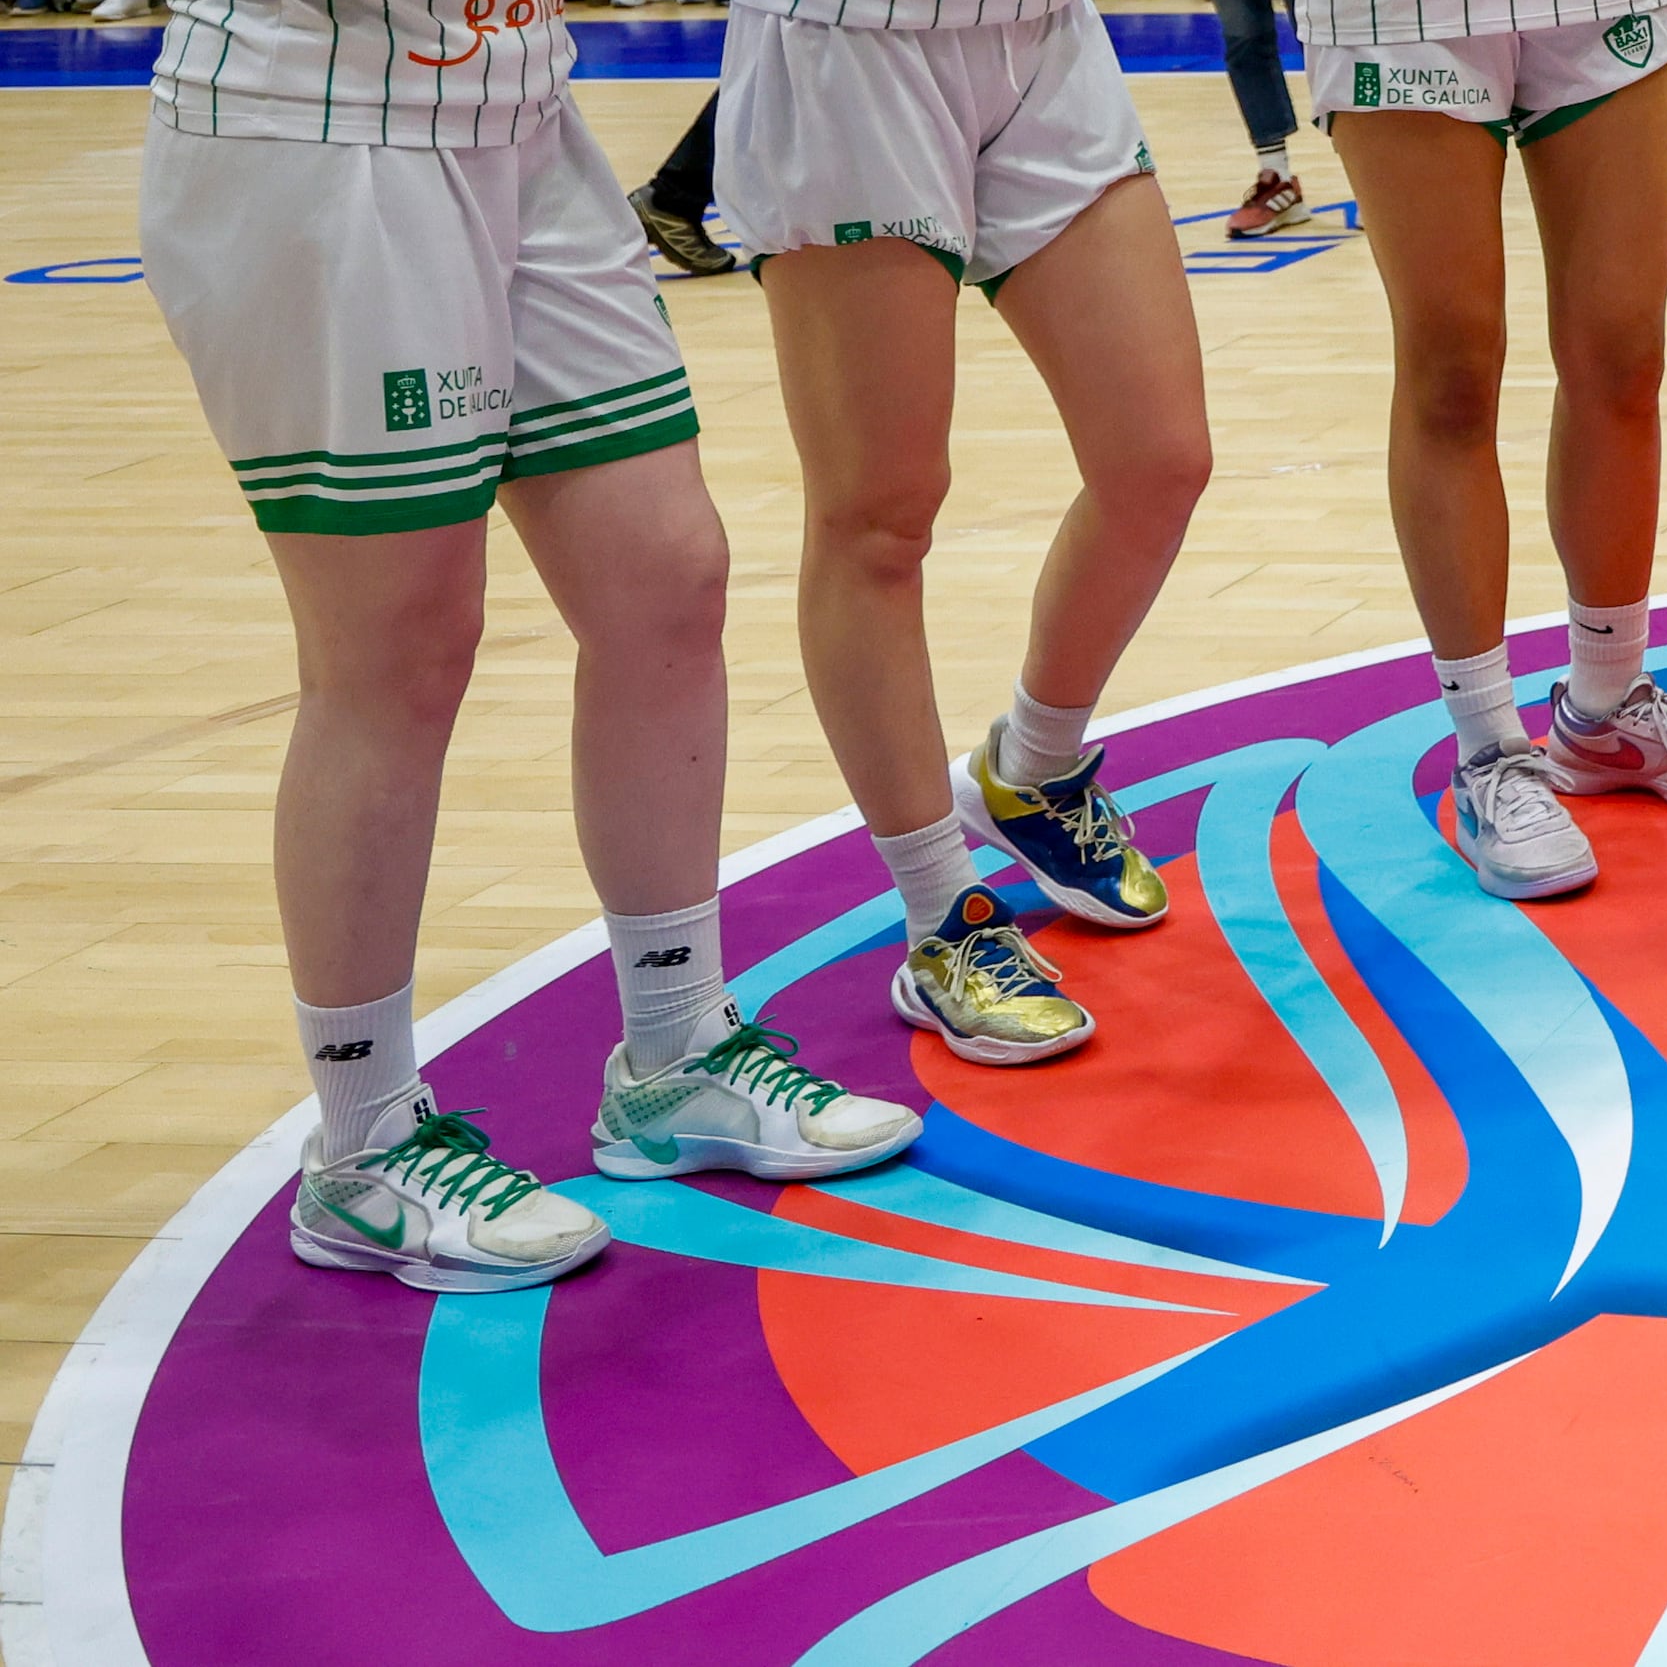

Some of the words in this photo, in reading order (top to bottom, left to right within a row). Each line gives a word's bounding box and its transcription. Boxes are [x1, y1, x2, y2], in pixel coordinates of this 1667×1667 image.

[1614, 26, 1648, 50] BAXI
[1388, 67, 1460, 86] XUNTA
[1386, 90, 1414, 105] DE
[1422, 88, 1492, 105] GALICIA
[439, 397, 467, 420] DE
